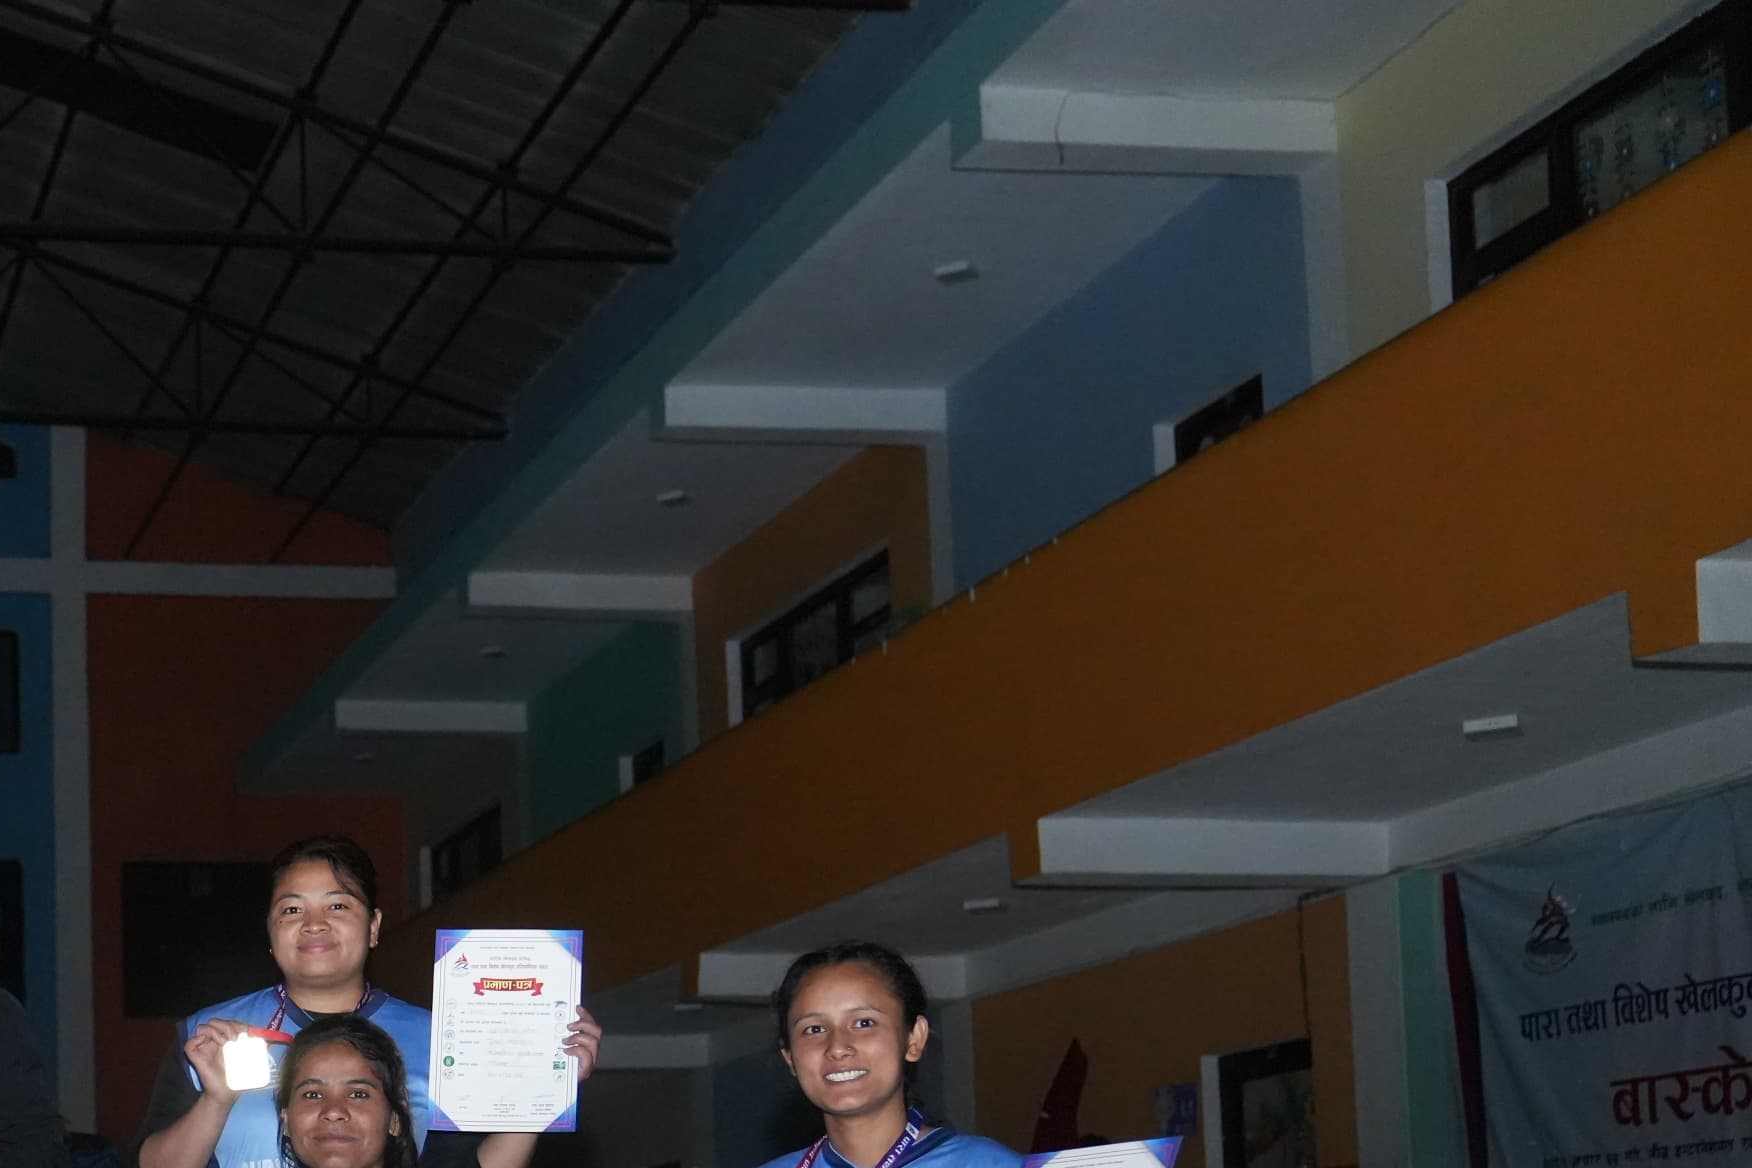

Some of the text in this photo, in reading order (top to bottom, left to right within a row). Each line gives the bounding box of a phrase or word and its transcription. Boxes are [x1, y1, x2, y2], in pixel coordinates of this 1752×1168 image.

[1519, 1010, 1561, 1042] पारा
[1564, 998, 1608, 1034] तथा
[1674, 972, 1752, 1018] खेलकु
